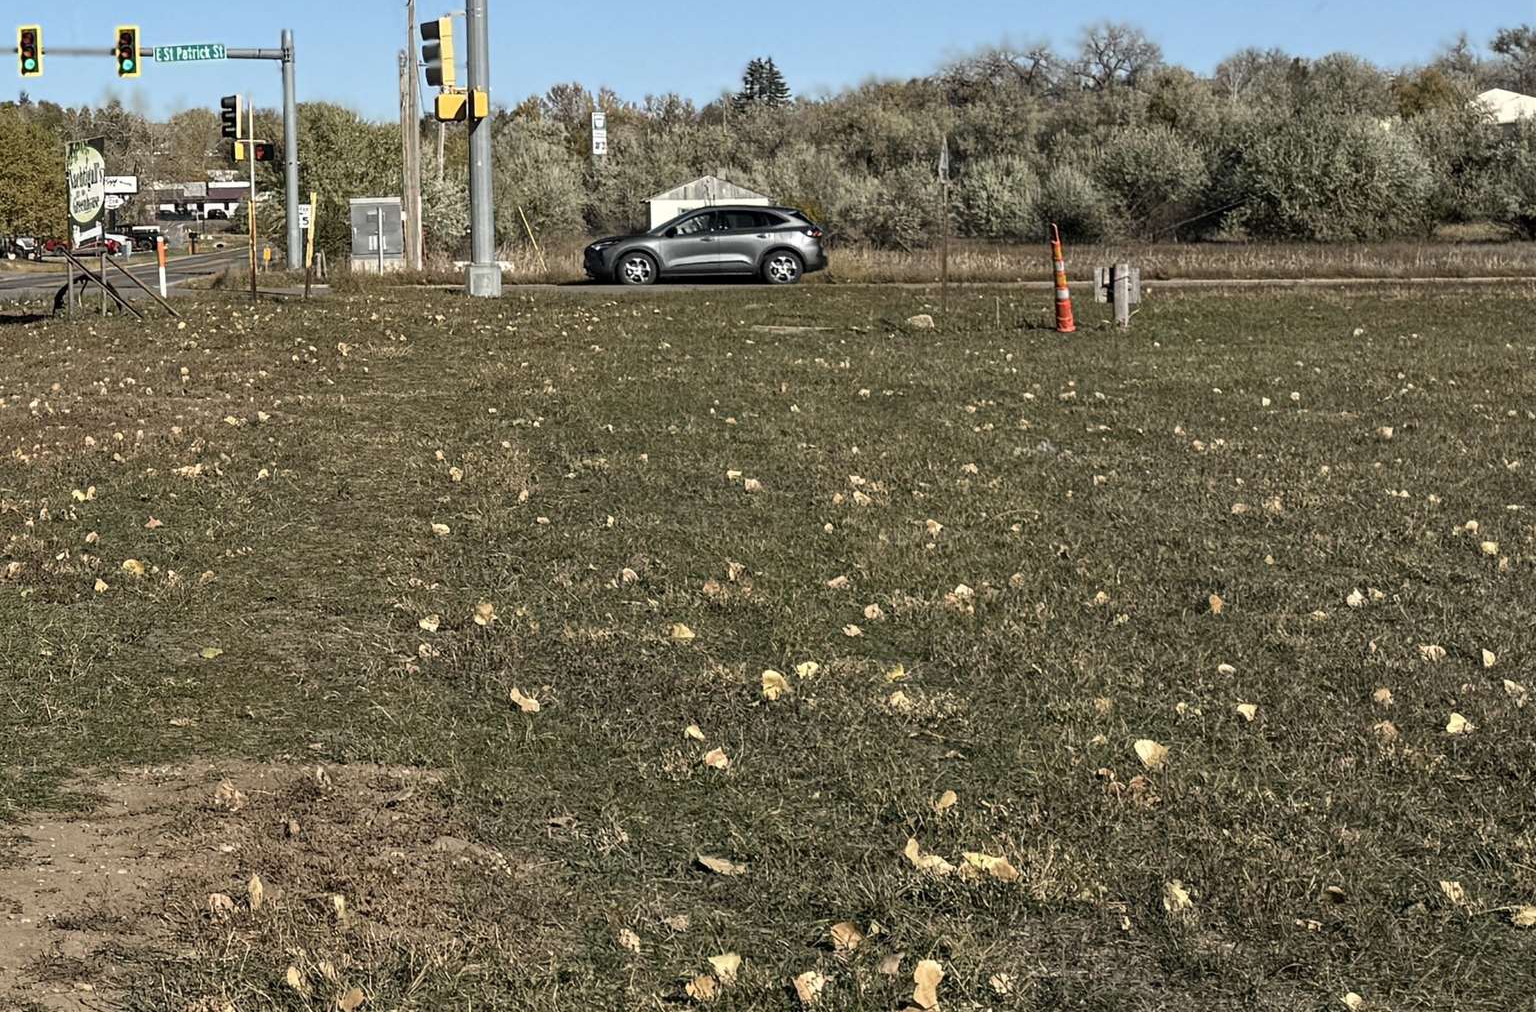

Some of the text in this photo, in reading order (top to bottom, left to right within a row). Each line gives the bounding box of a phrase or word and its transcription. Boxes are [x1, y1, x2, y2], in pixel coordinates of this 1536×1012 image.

[156, 45, 224, 61] E St Patrick St
